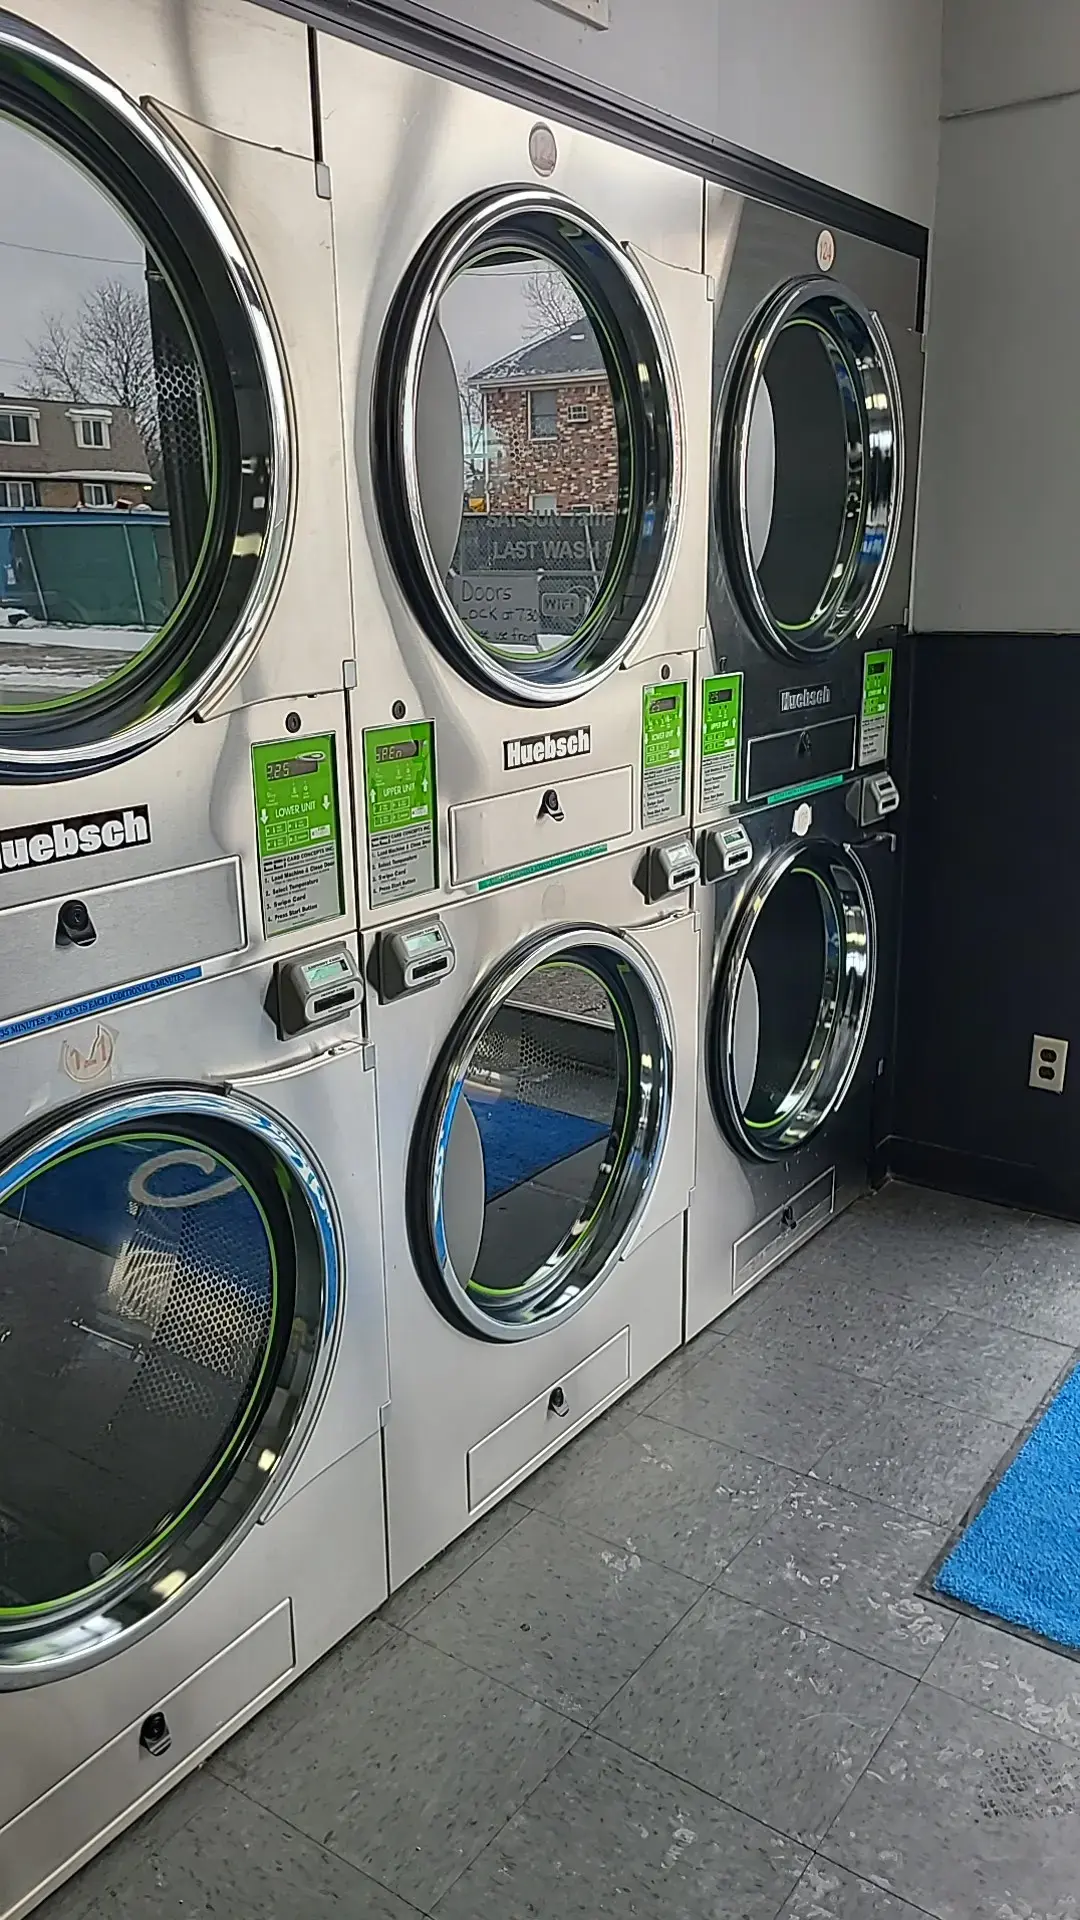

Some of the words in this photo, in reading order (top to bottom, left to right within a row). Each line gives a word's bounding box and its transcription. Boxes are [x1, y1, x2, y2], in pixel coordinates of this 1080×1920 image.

[819, 240, 832, 261] 124
[493, 540, 539, 560] LAST
[542, 540, 601, 560] WASH
[782, 685, 830, 711] Huebsch
[506, 729, 590, 767] Huebsch
[383, 785, 402, 797] UPPER
[402, 782, 416, 793] UNIT
[275, 804, 300, 818] LOWER
[300, 800, 316, 812] UNIT
[0, 810, 148, 870] uebsch
[287, 854, 300, 863] CARD
[300, 847, 325, 859] CONCEPTS
[271, 874, 284, 882] Load
[284, 869, 305, 878] Machine
[310, 864, 323, 872] Close
[272, 885, 288, 895] Select
[289, 878, 319, 890] Temperature
[273, 898, 292, 908] Swipe
[292, 893, 306, 902] Card
[274, 912, 288, 920] Press
[289, 908, 301, 916] Start
[301, 904, 318, 913] Button
[11, 1017, 46, 1033] MINUTES
[64, 1003, 88, 1015] CENTS
[88, 996, 108, 1009] EACH
[109, 984, 150, 1002] ADDITIONAL
[156, 973, 186, 988] MINUTES
